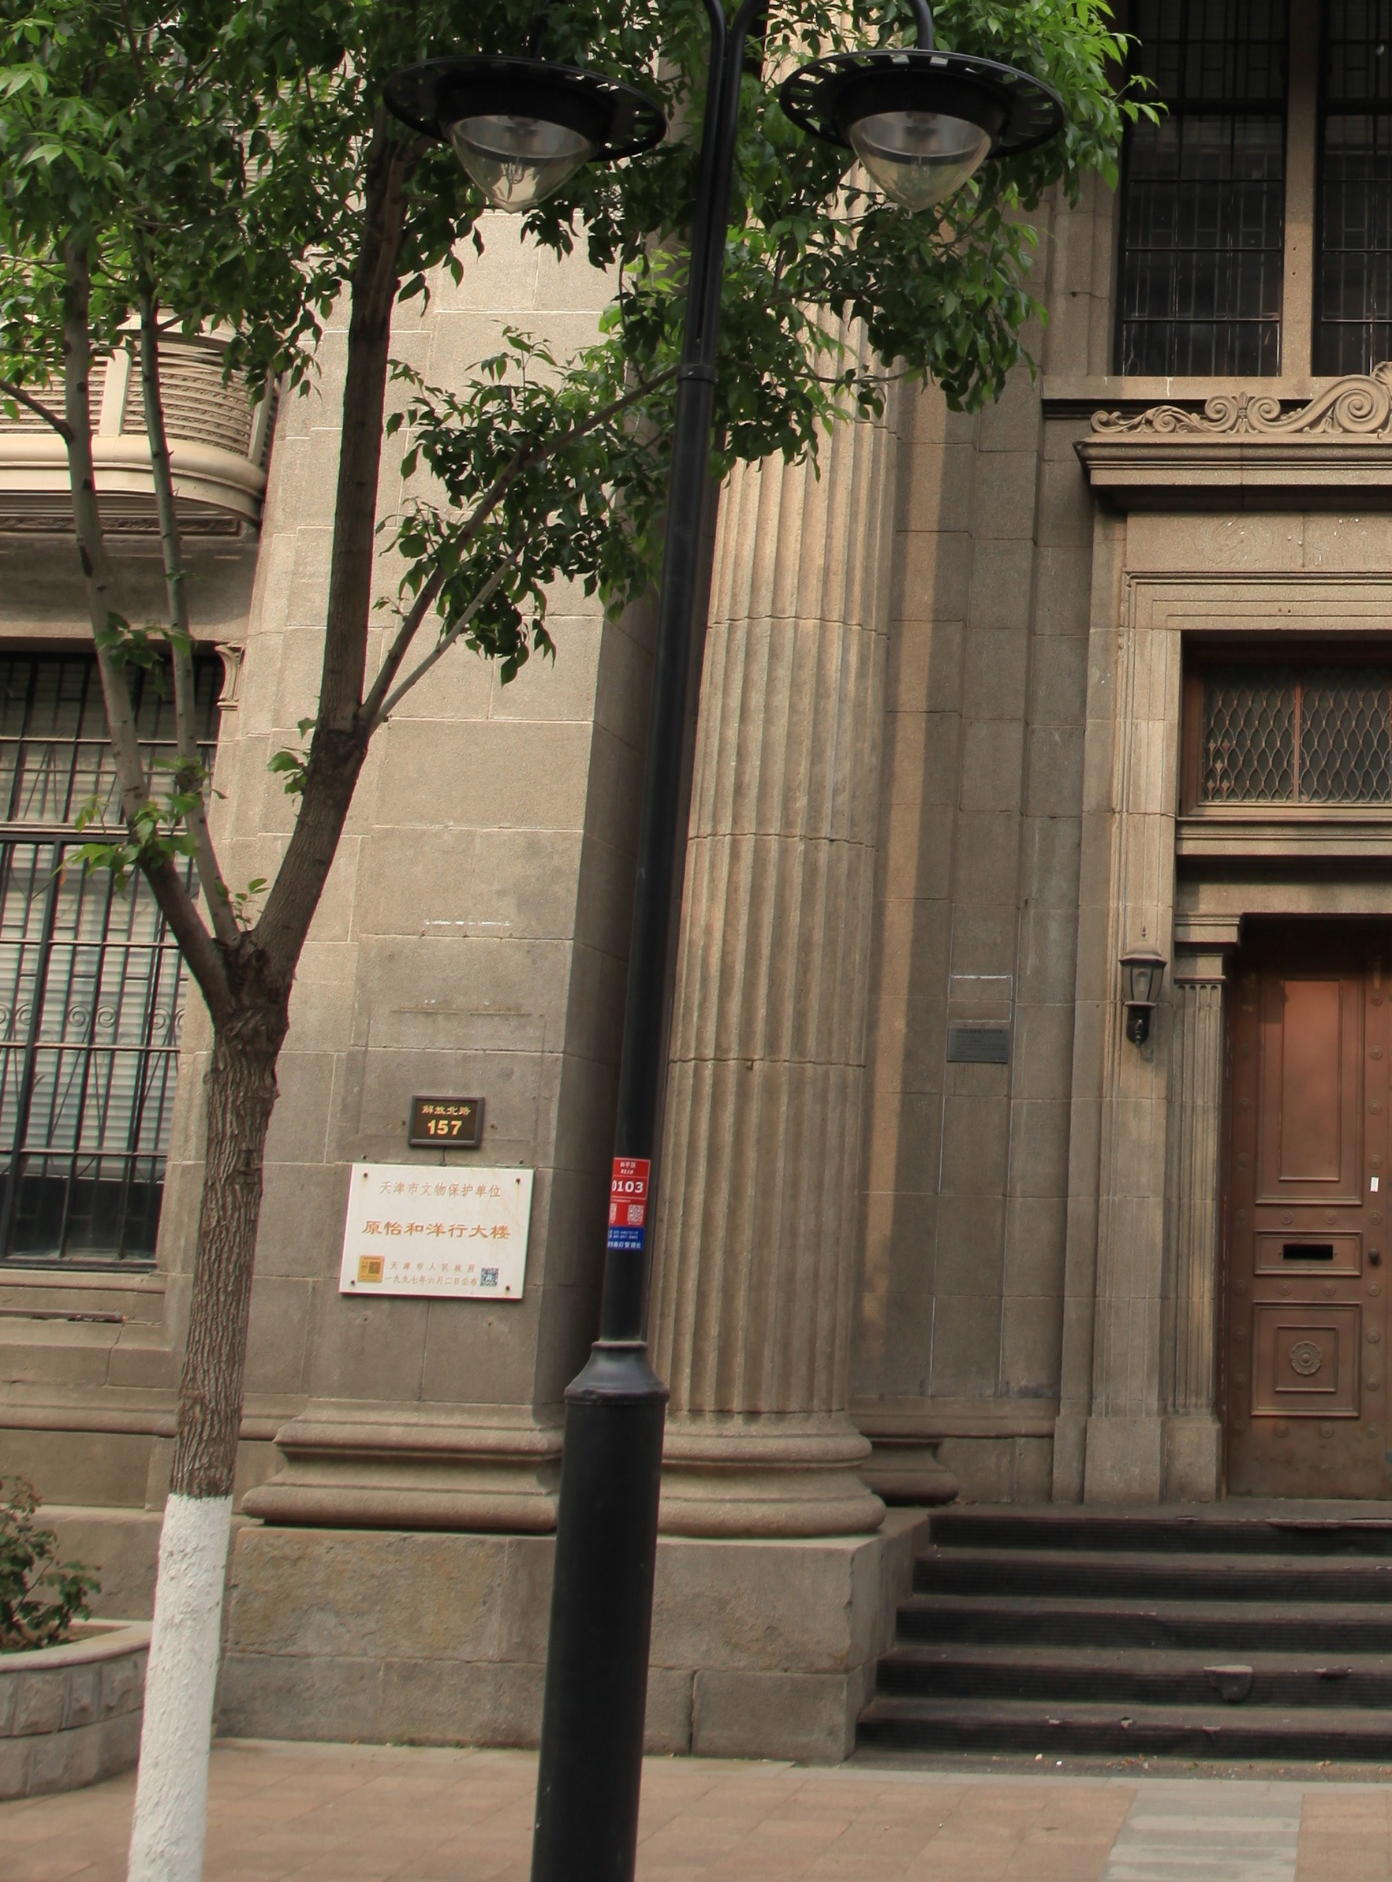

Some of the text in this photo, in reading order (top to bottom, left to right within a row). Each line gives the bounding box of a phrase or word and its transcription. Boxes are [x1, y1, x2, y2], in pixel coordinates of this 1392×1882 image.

[427, 1119, 462, 1136] 157
[379, 1181, 501, 1198] 天津市文物保护单位
[361, 1220, 511, 1240] 原怡和洋行大楼
[389, 1260, 475, 1273] 天津市人民政府
